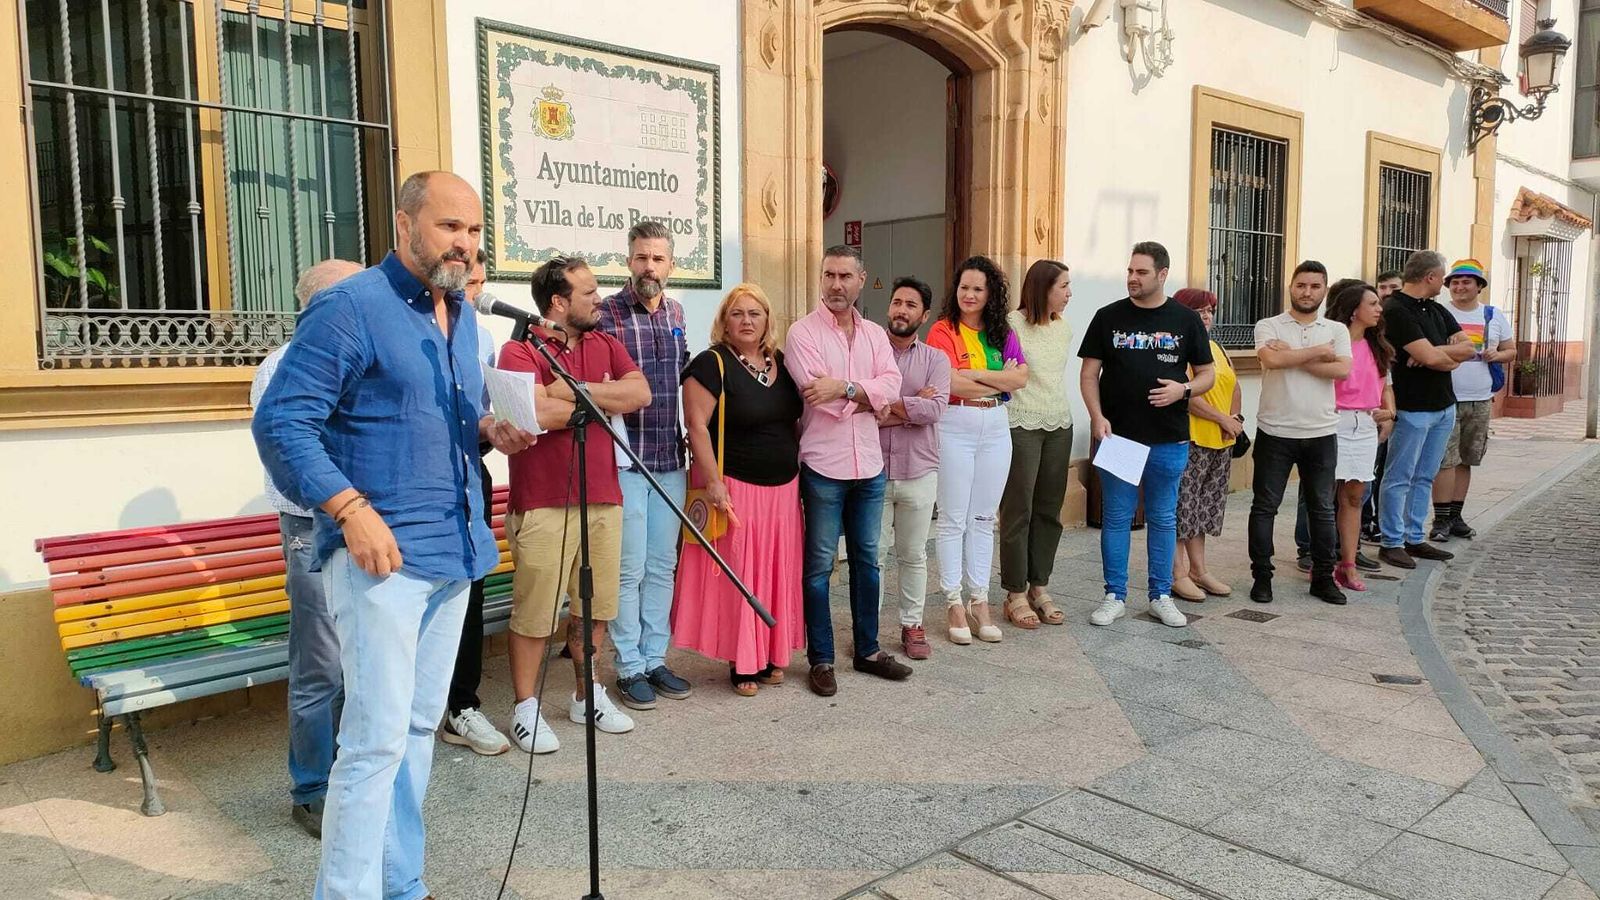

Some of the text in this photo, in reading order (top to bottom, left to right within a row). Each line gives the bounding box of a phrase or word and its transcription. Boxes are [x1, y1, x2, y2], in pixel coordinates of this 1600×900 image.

[537, 151, 679, 193] Ayuntamiento
[523, 199, 573, 227] Villa
[577, 205, 595, 228] de
[597, 205, 624, 230] Los
